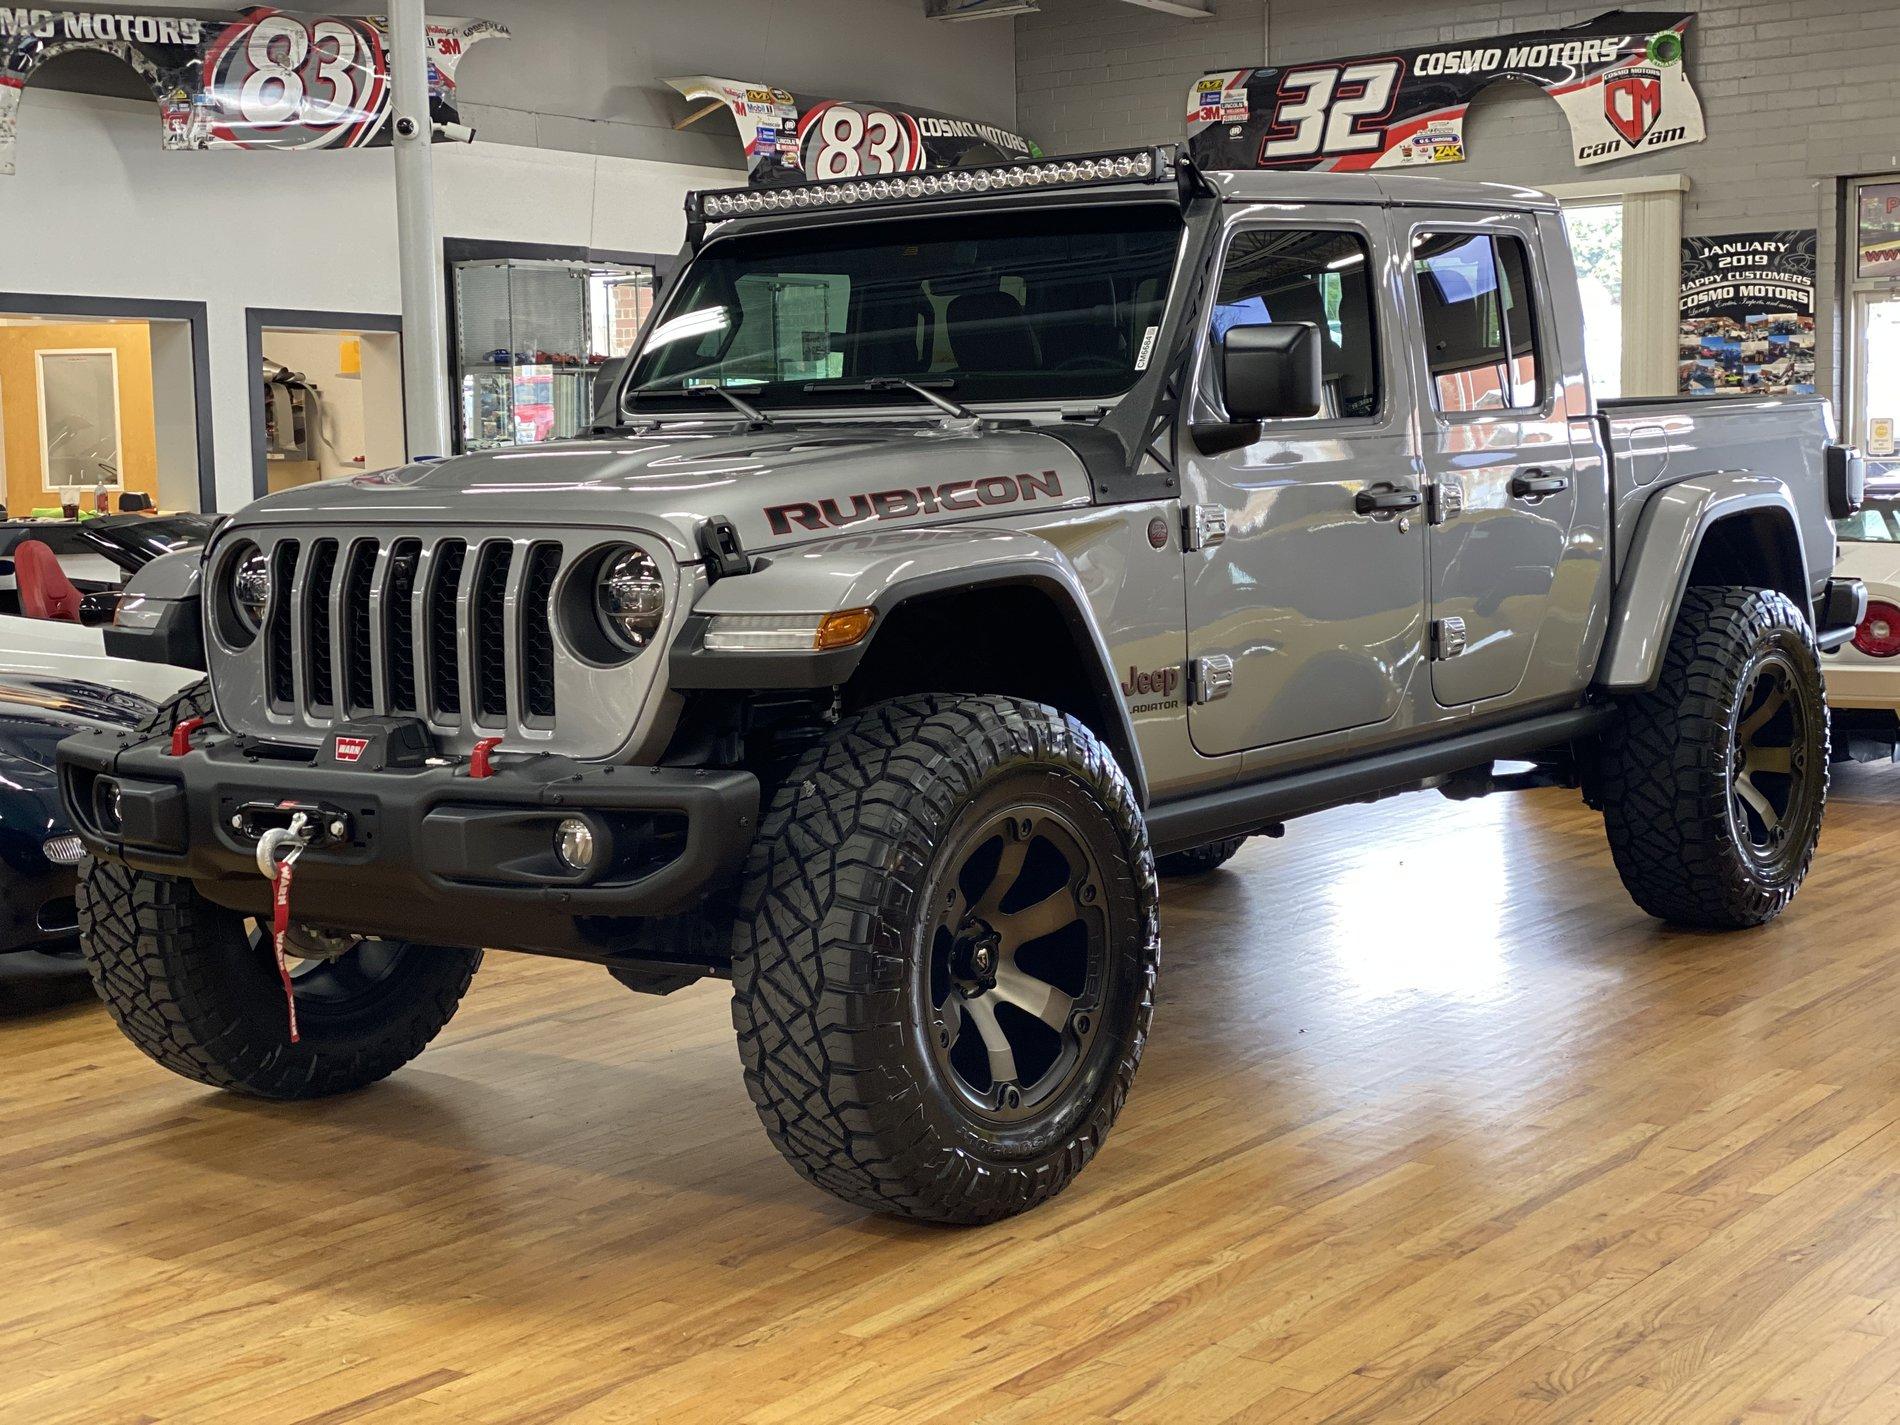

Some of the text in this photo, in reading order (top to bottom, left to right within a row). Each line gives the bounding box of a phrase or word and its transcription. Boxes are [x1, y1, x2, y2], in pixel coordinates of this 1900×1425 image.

[62, 11, 201, 45] MOTORS
[437, 38, 461, 55] 3M
[1413, 37, 1620, 76] COSMO MOTORS
[240, 16, 356, 125] 83
[1604, 69, 1629, 80] COSMO
[1630, 67, 1660, 77] MOTORS
[1201, 106, 1220, 120] 3M
[1264, 60, 1395, 158] 32
[817, 106, 898, 180] 83
[919, 117, 1029, 153] COSMO MOTORS
[1579, 126, 1685, 160] can am
[1435, 144, 1460, 157] ZAK
[1699, 242, 1790, 259] JANUARY
[1719, 254, 1768, 268] 2019
[1728, 271, 1811, 286] CUSTOMERS
[1680, 285, 1808, 310] COSMO MOTORS
[763, 470, 1063, 536] RUBICON
[1121, 665, 1179, 697] Jeep
[1130, 701, 1178, 713] ADIATOR
[338, 744, 361, 755] WARN
[278, 865, 291, 905] WARN
